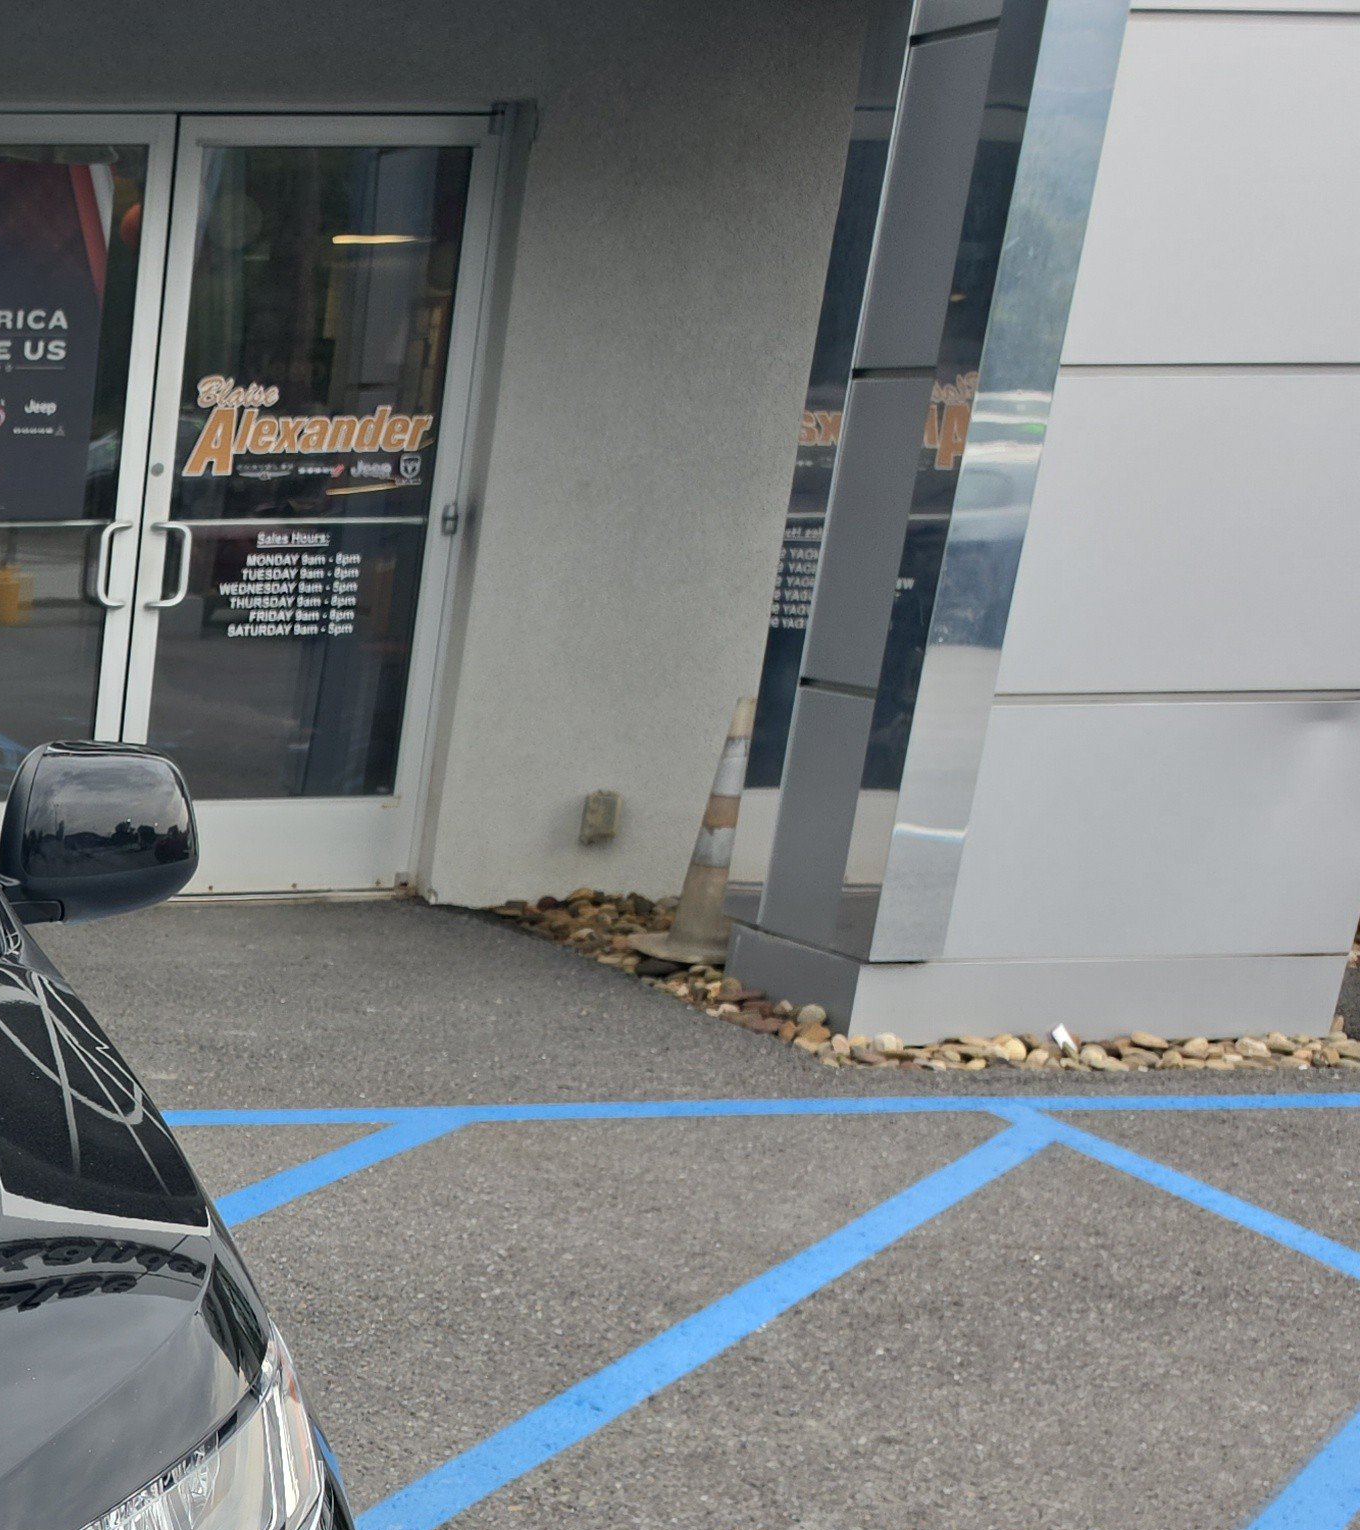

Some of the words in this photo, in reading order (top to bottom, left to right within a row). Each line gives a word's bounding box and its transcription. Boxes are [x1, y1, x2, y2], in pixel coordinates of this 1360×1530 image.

[23, 339, 67, 361] US
[197, 373, 280, 408] Blaise
[24, 399, 57, 416] Jeep
[181, 404, 433, 477] Alexander
[350, 459, 392, 479] Jeep
[257, 531, 289, 546] Sales
[246, 552, 300, 567] MONDAY
[242, 566, 299, 580] TUESDAY
[219, 580, 297, 595] WEDNESDAY
[229, 595, 296, 609] THURSDAY
[248, 608, 294, 622] FRIDAY
[227, 622, 293, 638] SATURDAY
